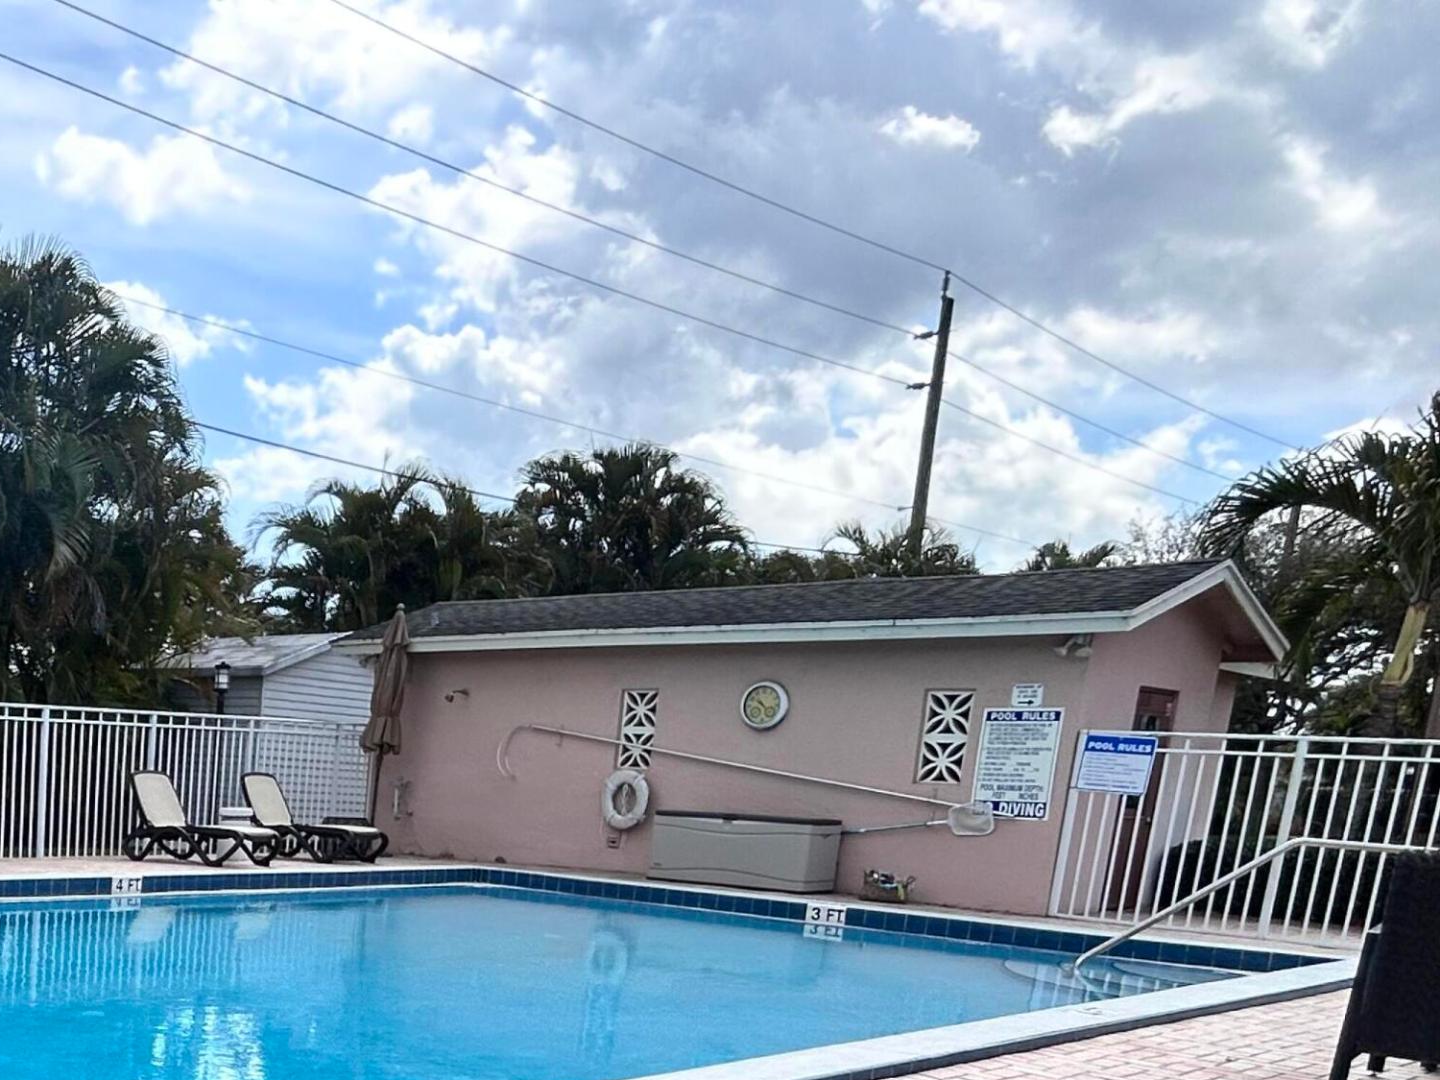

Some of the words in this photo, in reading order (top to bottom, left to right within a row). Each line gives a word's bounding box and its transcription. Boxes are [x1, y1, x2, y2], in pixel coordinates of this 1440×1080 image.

[990, 711, 1017, 721] POOL
[1021, 711, 1056, 721] RULES
[1088, 741, 1115, 751] POOL
[1117, 743, 1152, 753] RULES
[999, 802, 1045, 817] DIVING
[116, 878, 123, 892] 4
[811, 907, 821, 921] 3
